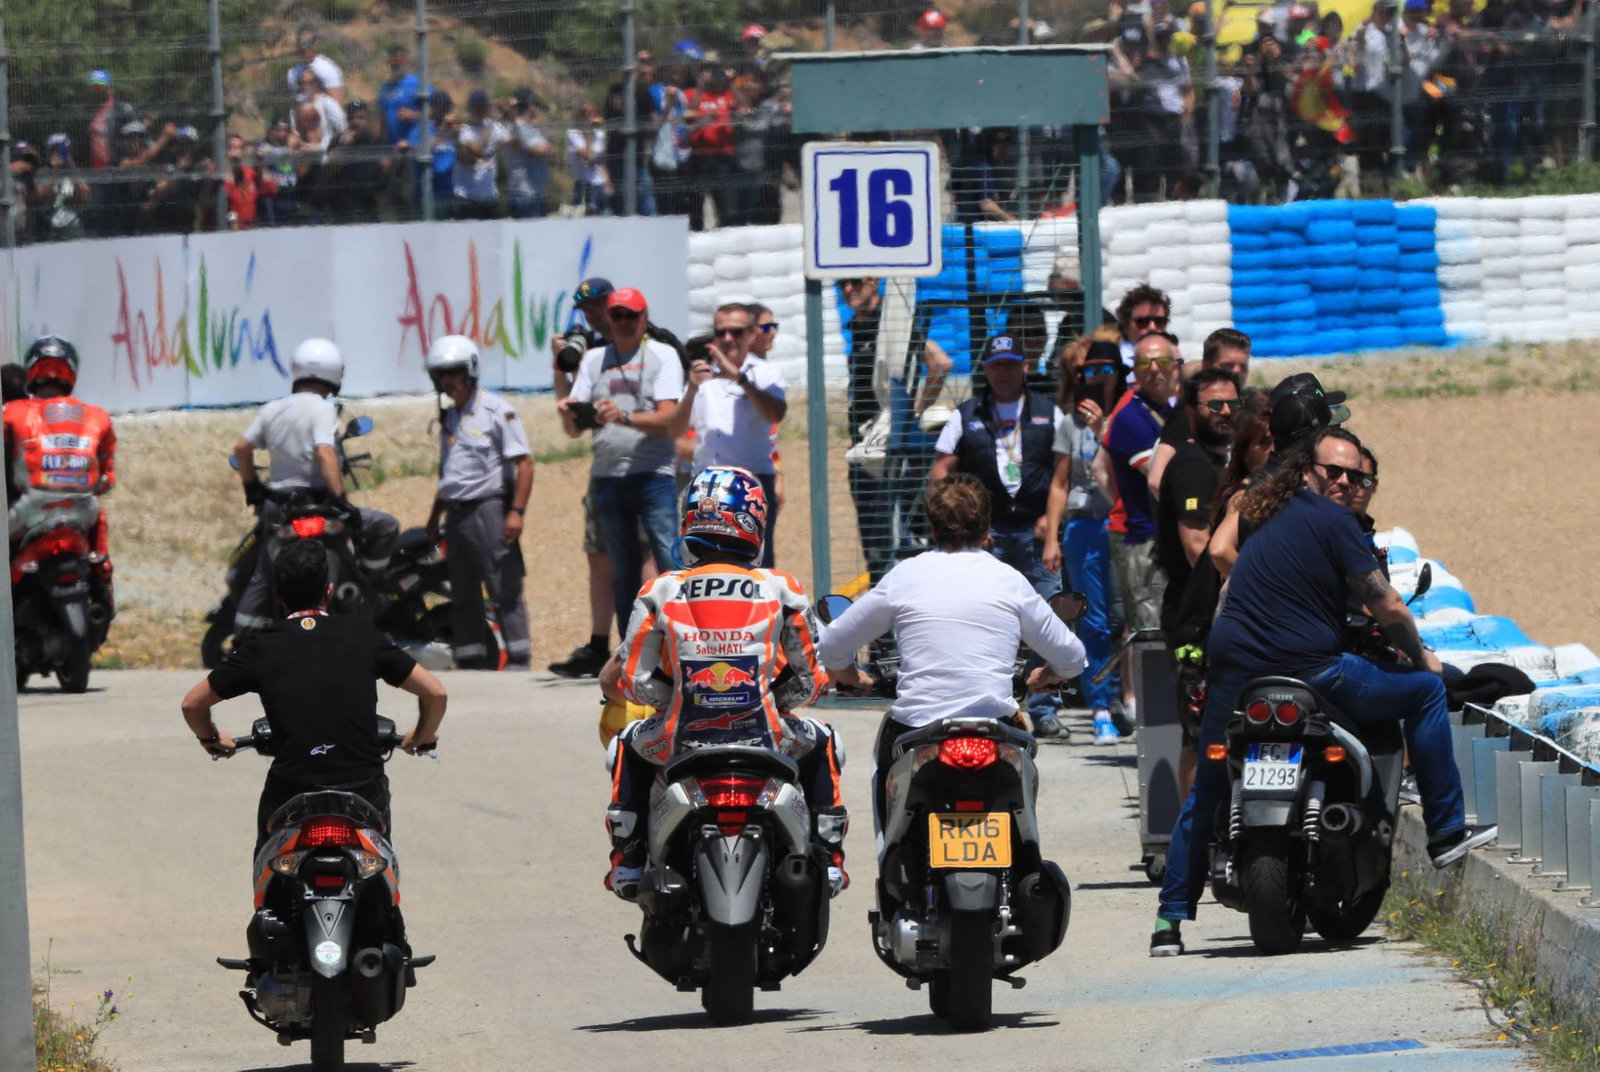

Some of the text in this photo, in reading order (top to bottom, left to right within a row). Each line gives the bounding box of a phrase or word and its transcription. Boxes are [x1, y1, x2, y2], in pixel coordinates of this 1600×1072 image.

[829, 168, 914, 248] 16
[675, 577, 765, 600] REPSOL
[683, 630, 756, 642] HONDA
[1245, 766, 1297, 787] 21293
[939, 818, 1000, 839] RK16
[943, 841, 998, 862] LDA
